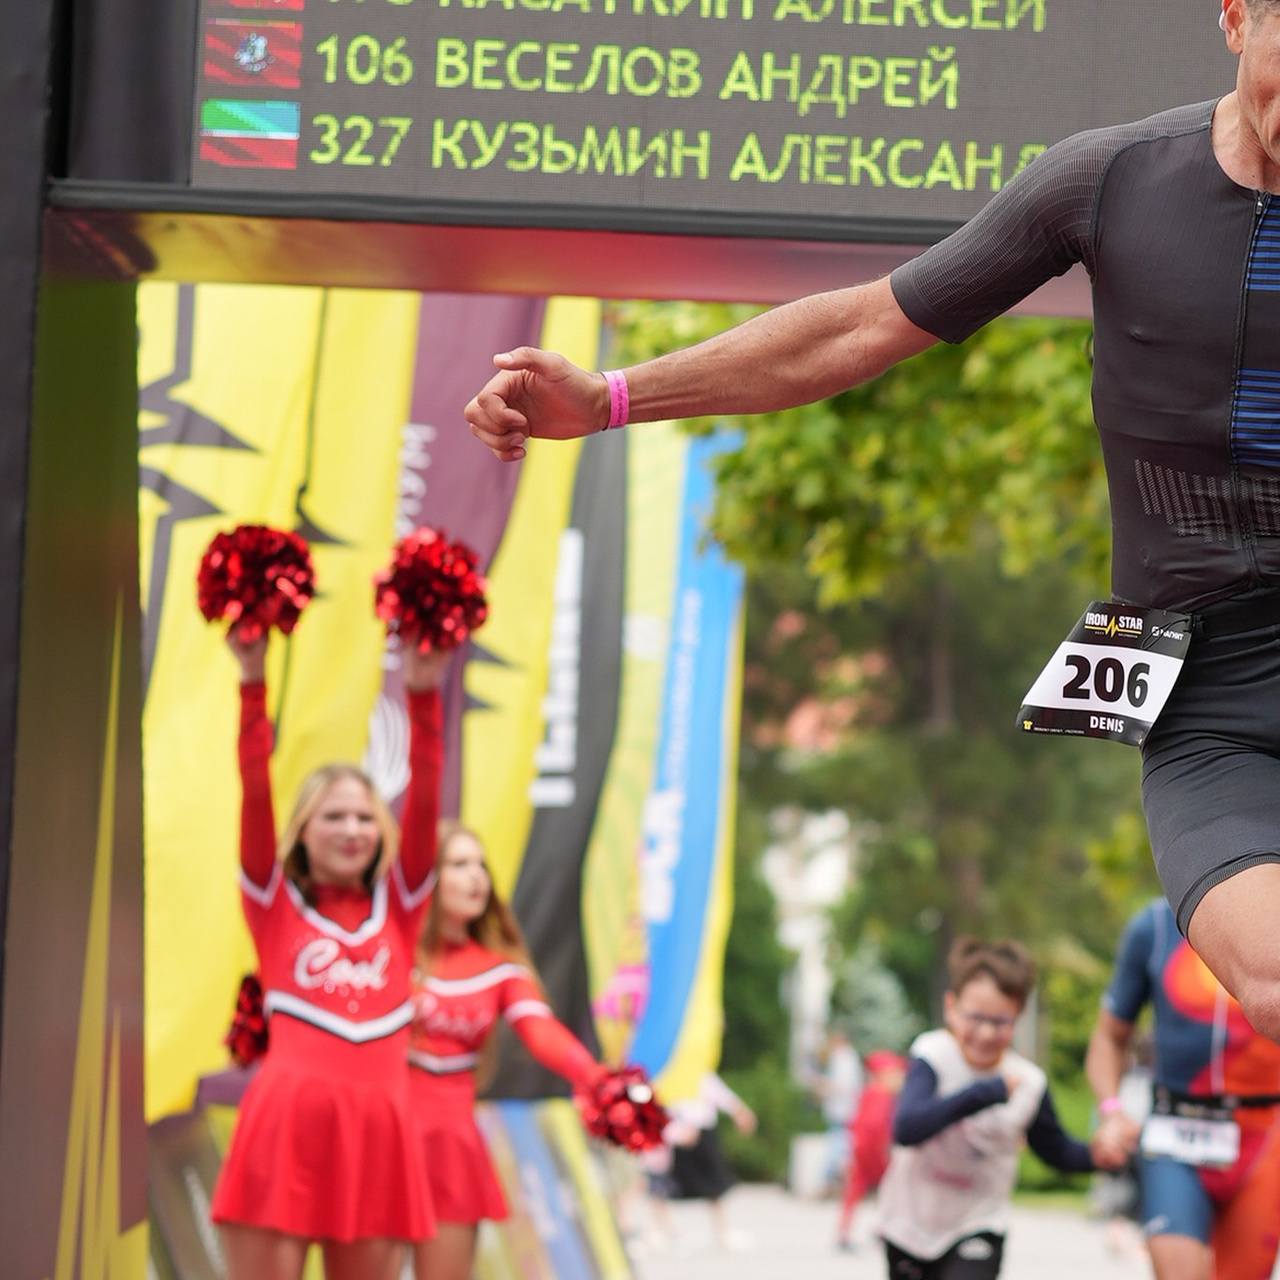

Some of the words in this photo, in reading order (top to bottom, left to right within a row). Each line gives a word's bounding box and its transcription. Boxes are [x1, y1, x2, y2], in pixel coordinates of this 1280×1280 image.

[315, 33, 415, 86] 106
[434, 36, 703, 99] ВЕСЕЛОВ
[719, 43, 960, 118] АНДРЕЙ
[308, 112, 413, 167] 327
[430, 116, 712, 180] КУЗЬМИН
[1085, 612, 1108, 627] IRON
[1118, 617, 1143, 631] STAR
[1062, 655, 1151, 708] 206
[1090, 716, 1124, 733] DENIS
